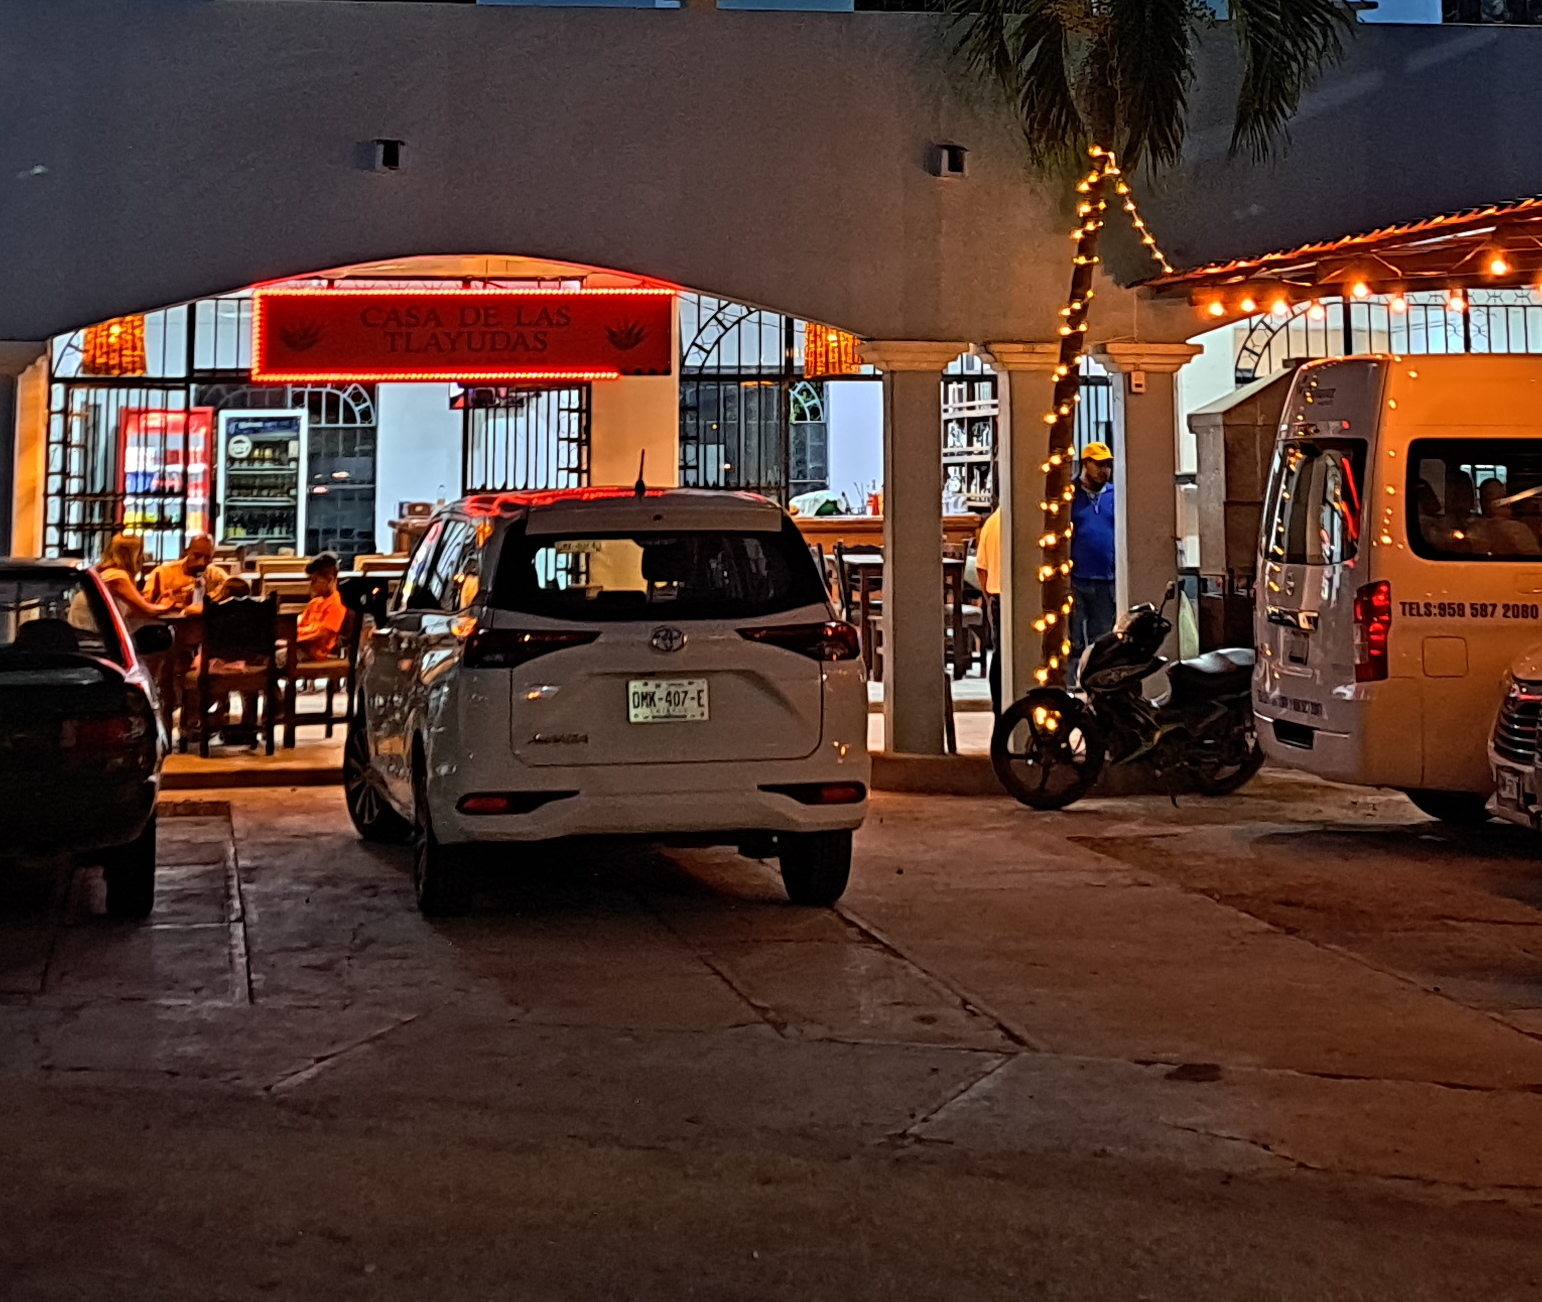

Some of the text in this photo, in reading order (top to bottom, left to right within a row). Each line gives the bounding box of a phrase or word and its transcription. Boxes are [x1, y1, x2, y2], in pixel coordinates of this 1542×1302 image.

[360, 305, 572, 328] CASA DE LAS
[383, 330, 549, 353] TLAYUDAS
[1469, 602, 1498, 618] 587
